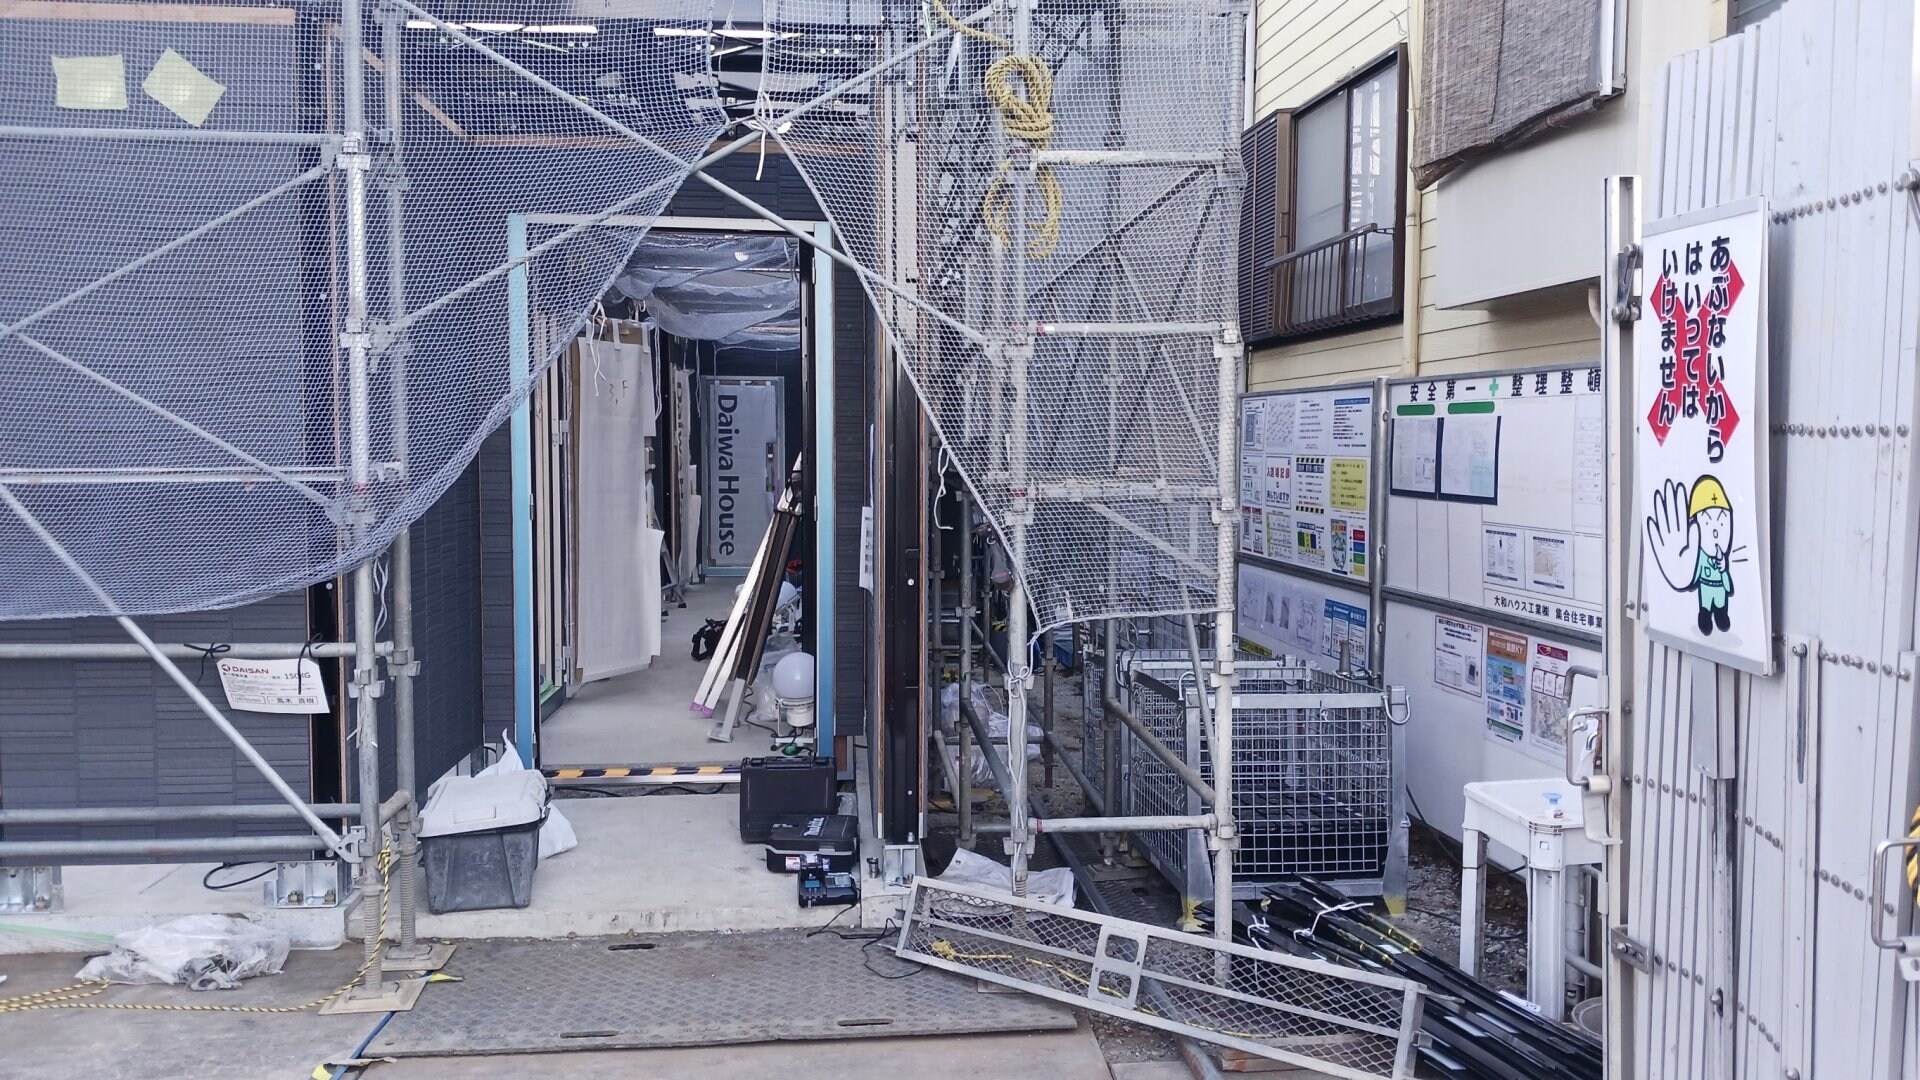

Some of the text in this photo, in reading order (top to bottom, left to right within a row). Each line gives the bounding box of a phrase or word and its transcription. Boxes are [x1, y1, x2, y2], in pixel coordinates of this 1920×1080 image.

[1410, 368, 1601, 402] 安全第一 整理整頓
[1657, 248, 1679, 427] いけません
[1682, 240, 1704, 419] はいっては
[1705, 235, 1730, 464] あぶないから
[718, 394, 740, 556] Daiwa House
[231, 665, 269, 674] DAISAN
